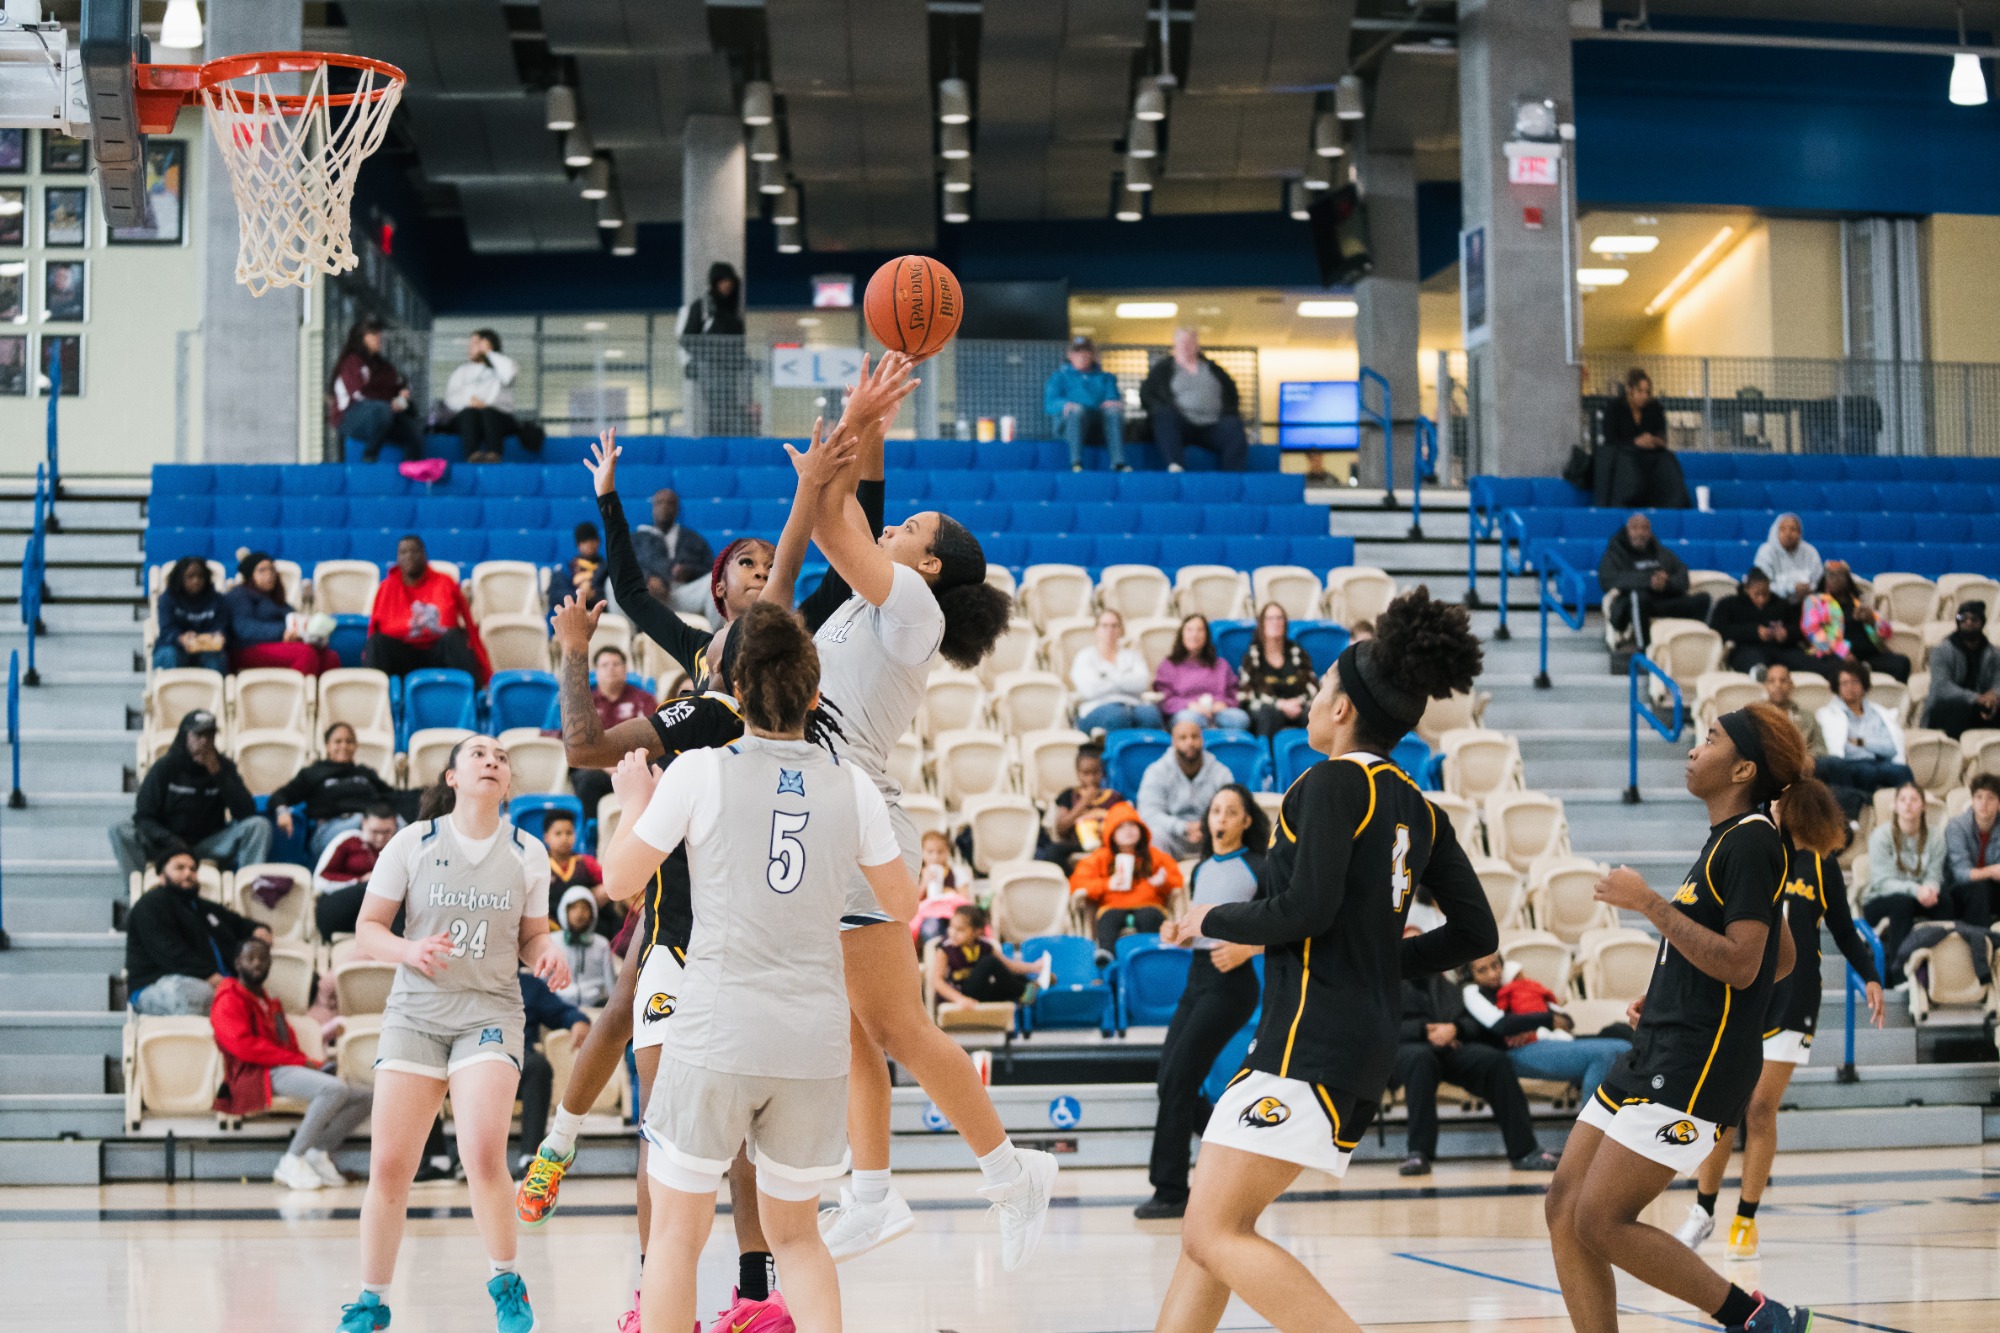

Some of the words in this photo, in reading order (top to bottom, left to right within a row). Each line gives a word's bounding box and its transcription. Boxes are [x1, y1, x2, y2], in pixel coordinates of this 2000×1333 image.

[909, 264, 925, 330] SPALDING
[766, 809, 810, 894] 5
[1391, 823, 1412, 913] 4
[428, 882, 512, 912] Harford
[449, 918, 488, 960] 24
